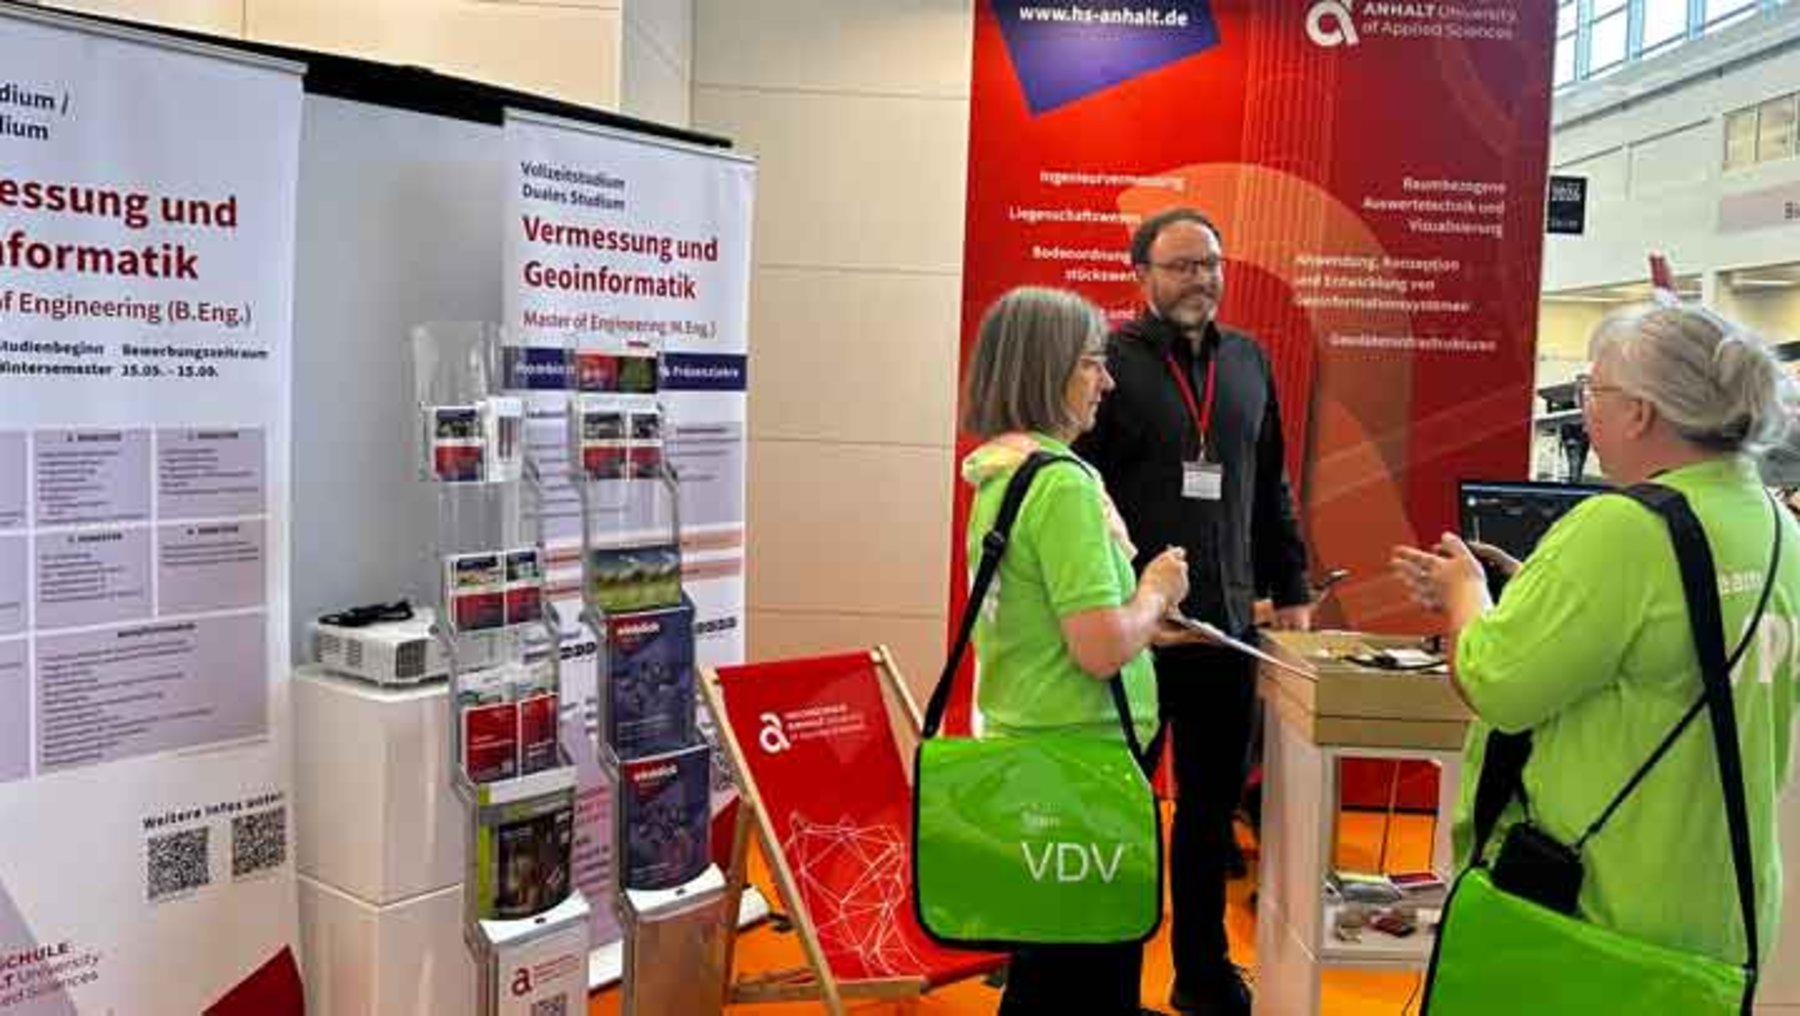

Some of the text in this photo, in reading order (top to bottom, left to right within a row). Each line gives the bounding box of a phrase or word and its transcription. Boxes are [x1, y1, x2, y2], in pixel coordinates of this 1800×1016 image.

[1019, 4, 1189, 27] www.hs-anhalt.de
[1363, 2, 1518, 23] ANHALT University
[1362, 21, 1515, 41] of Applied Sciences
[520, 162, 626, 190] Vollzeitstudium
[1402, 176, 1507, 196] Raumbezogene
[522, 184, 626, 211] Duales Studium
[1362, 196, 1506, 215] Auswertetechnik und
[160, 195, 238, 228] und
[1408, 217, 1504, 239] Visualisierung
[521, 215, 719, 264] Vermessung und
[0, 230, 200, 281] formatik
[1383, 254, 1461, 274] Konzeption
[523, 259, 697, 300] Geoinformatik
[1324, 275, 1408, 293] Entwicklung
[1411, 279, 1436, 293] von
[18, 291, 161, 324] Engineering
[167, 299, 252, 328] (B.Eng.)
[523, 310, 572, 332] Master
[575, 311, 589, 331] of
[590, 314, 667, 337] Engineering
[0, 340, 269, 361] tudienbeginn Bewerbungszeitraum
[673, 365, 740, 380] Präsenzlehre
[142, 808, 202, 830] Weitere
[1021, 840, 1125, 884] VDV
